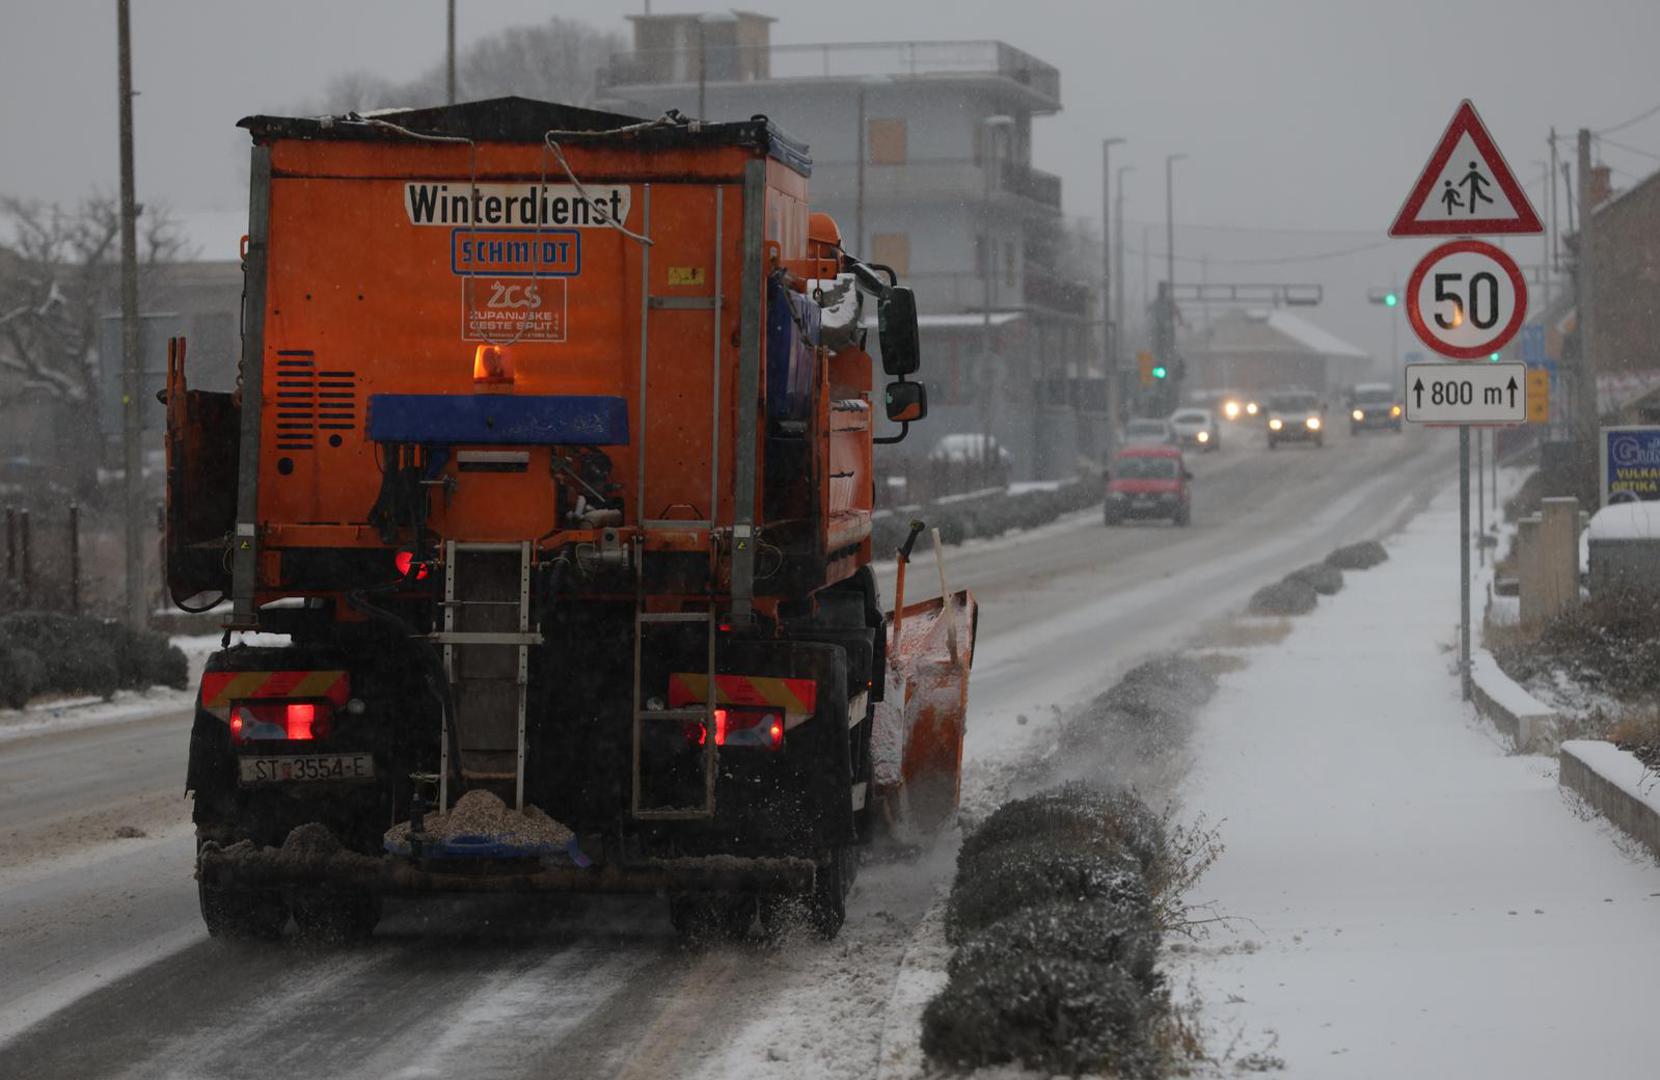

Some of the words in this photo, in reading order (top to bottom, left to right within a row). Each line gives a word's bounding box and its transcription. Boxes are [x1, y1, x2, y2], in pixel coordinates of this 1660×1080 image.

[409, 185, 622, 225] Winterdienst
[461, 241, 570, 264] SCHMIDT
[1434, 271, 1499, 330] 50
[1431, 381, 1473, 405] 800
[1484, 386, 1503, 405] m
[255, 759, 279, 780] ST
